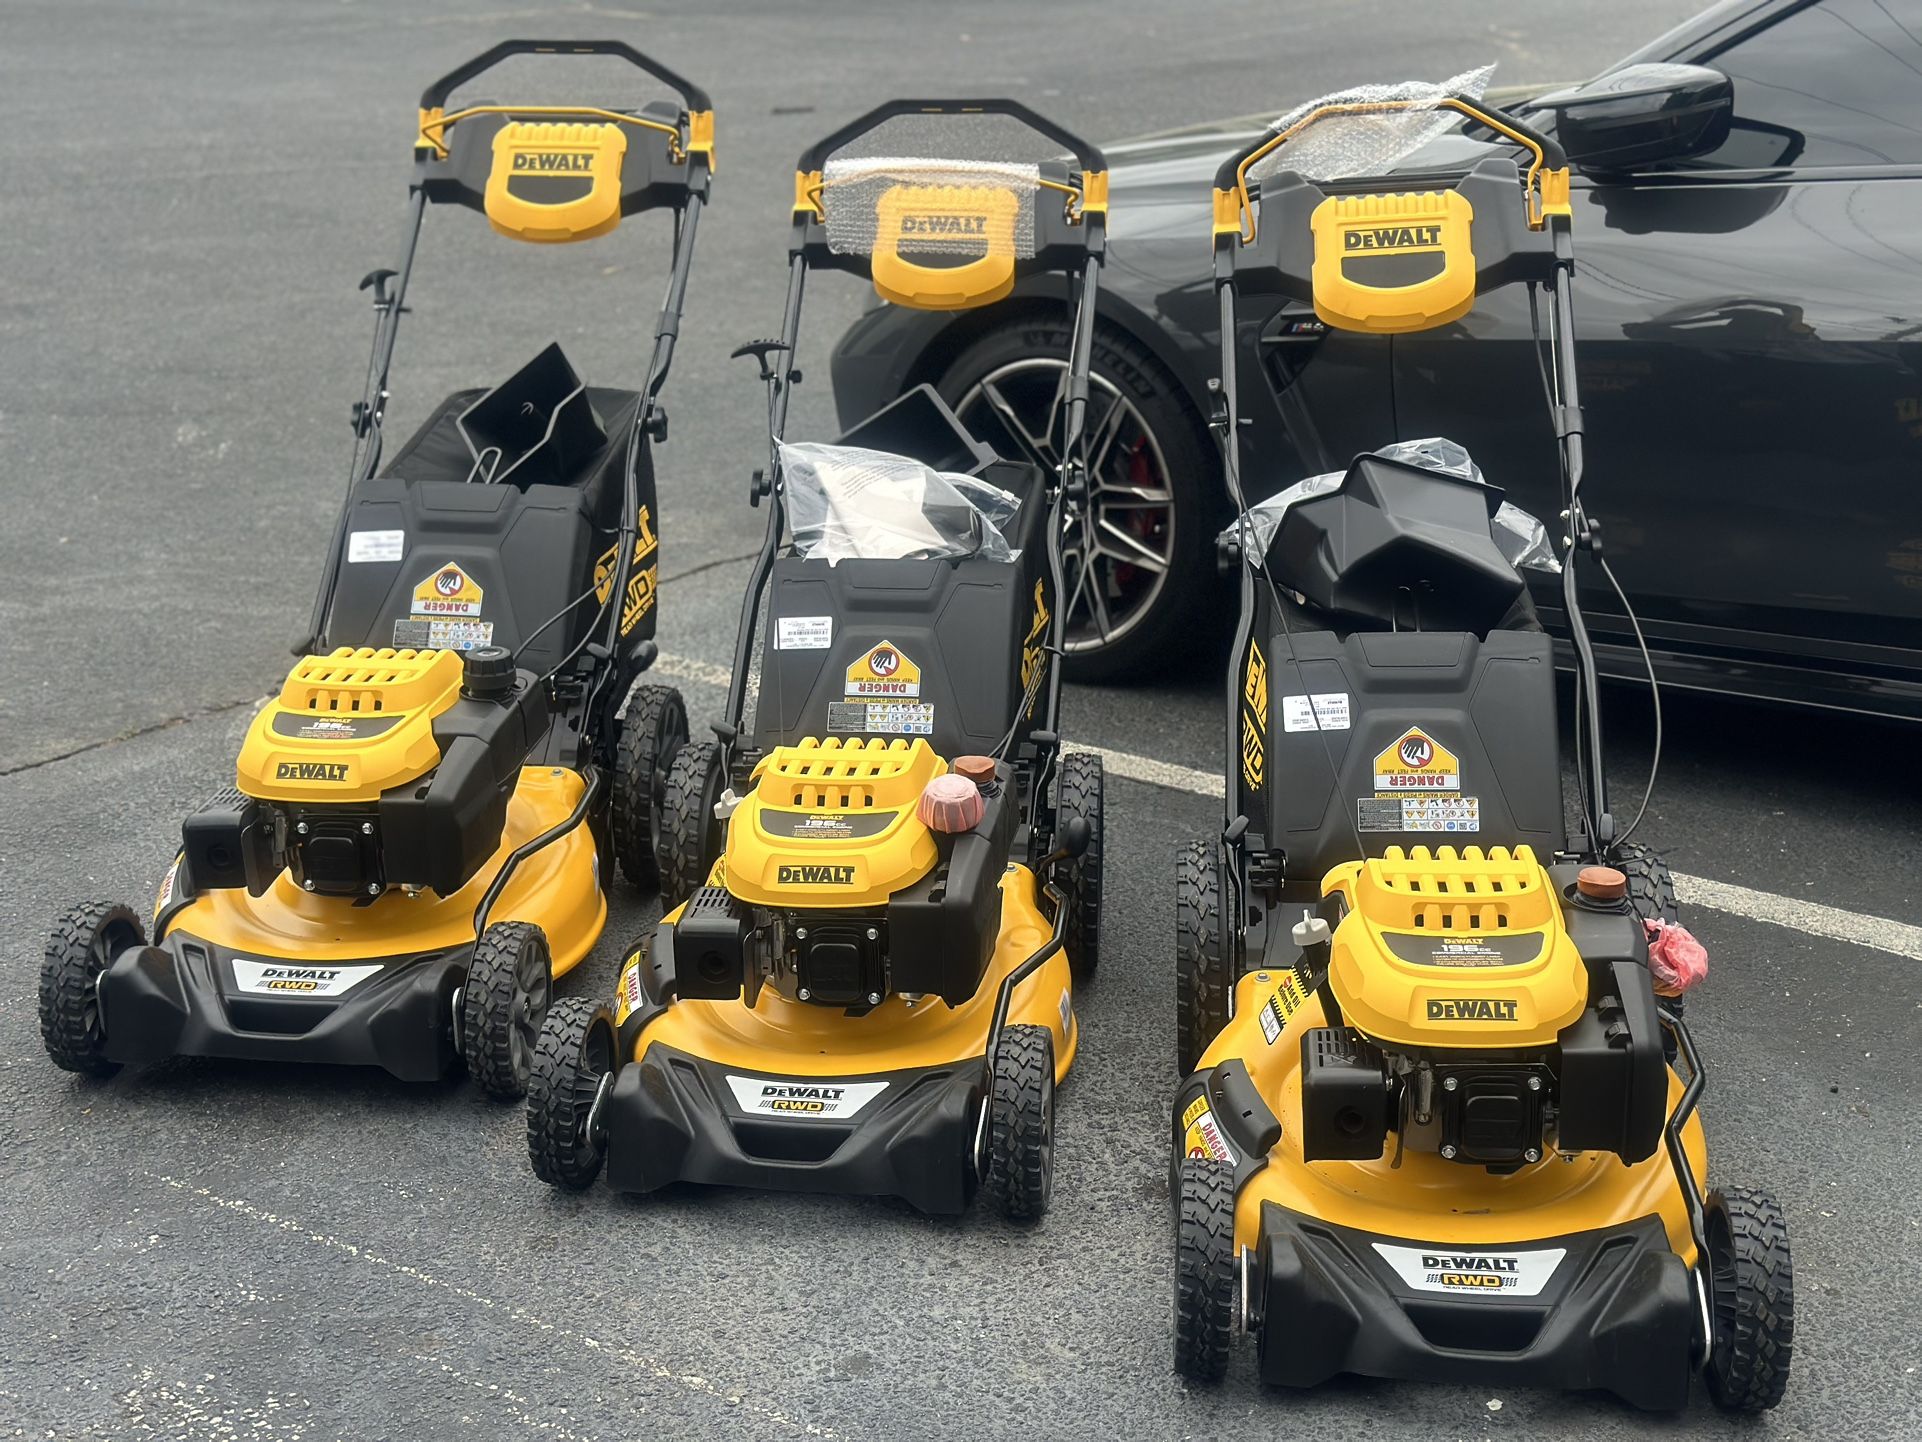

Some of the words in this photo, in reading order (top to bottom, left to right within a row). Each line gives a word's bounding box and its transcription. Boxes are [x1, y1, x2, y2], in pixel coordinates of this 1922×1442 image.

[512, 153, 594, 171] DEWALT
[1344, 225, 1441, 251] DEWALT
[424, 601, 469, 612] DANGER
[858, 683, 907, 693] DANGER
[276, 763, 349, 781] DEWALT
[1389, 775, 1445, 786] DANGER
[778, 865, 855, 884] DEWALT
[261, 967, 341, 981] DEWALT
[269, 981, 316, 990] RWD
[1427, 999, 1518, 1021] DEWALT
[761, 1086, 845, 1101] DEWALT
[773, 1100, 822, 1111] RWD
[1422, 1255, 1519, 1273] DEWALT
[1442, 1274, 1501, 1287] RWD
